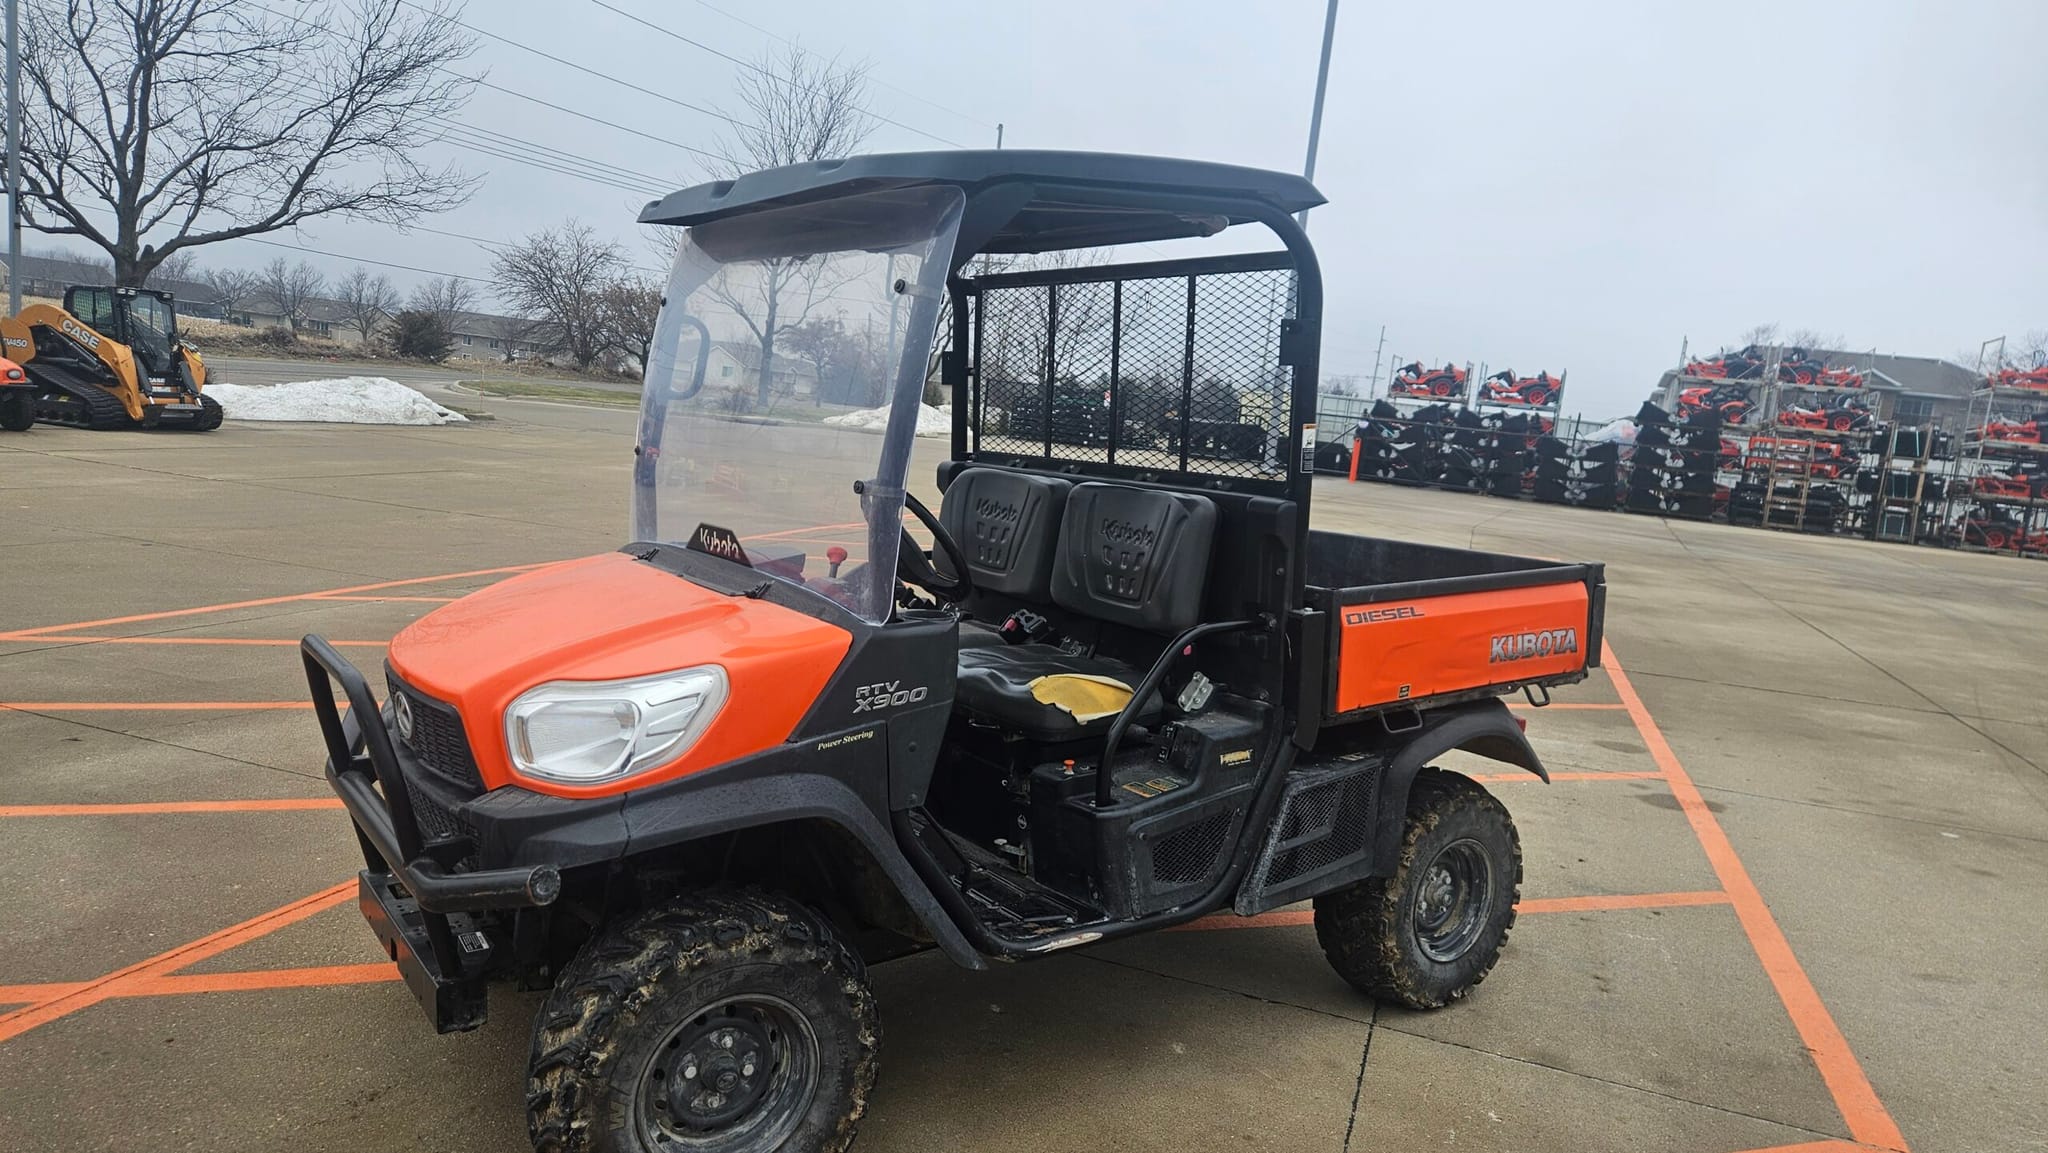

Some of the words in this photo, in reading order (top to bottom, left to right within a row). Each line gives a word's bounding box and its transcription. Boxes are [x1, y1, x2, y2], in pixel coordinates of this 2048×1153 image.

[62, 319, 100, 349] CASE
[700, 527, 740, 559] Kubota
[1345, 606, 1425, 625] DIESEL
[1489, 627, 1578, 664] KUBOTA
[852, 686, 928, 714] X900
[855, 680, 900, 698] RTV
[817, 739, 843, 751] Power
[842, 730, 874, 744] Steering
